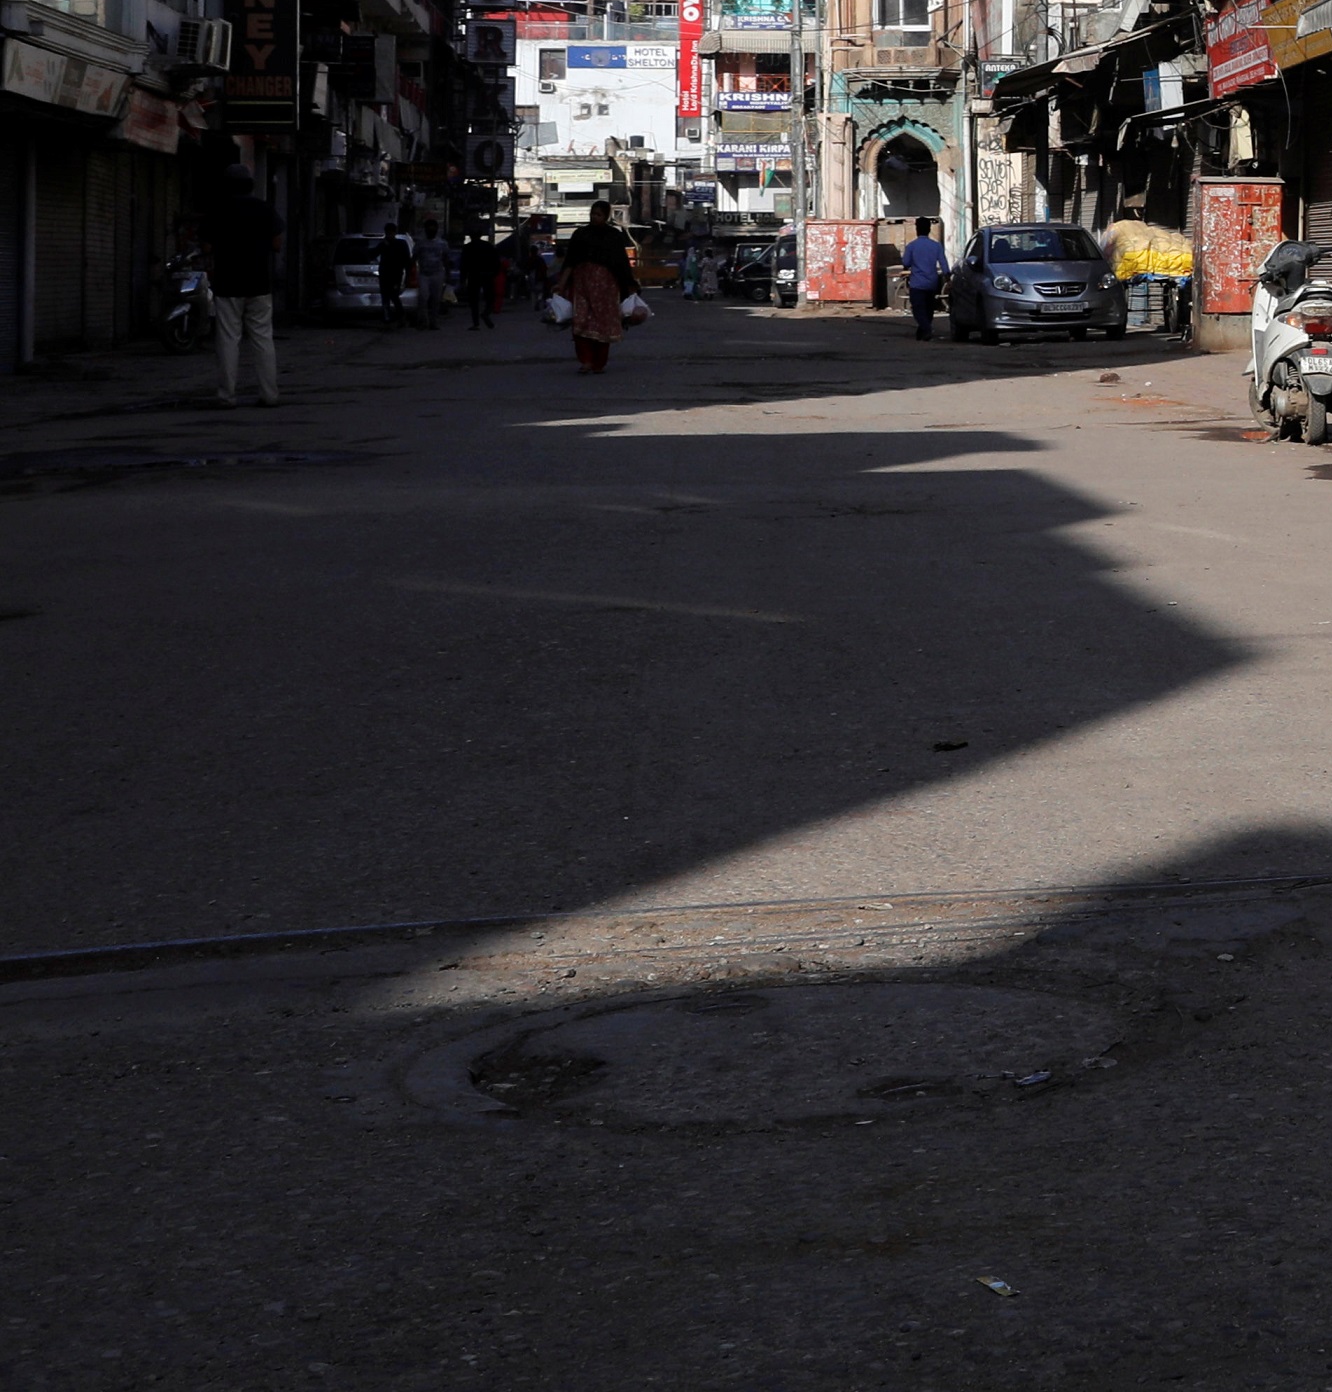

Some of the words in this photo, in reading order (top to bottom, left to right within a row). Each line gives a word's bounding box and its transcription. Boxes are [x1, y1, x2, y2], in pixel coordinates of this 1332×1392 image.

[634, 48, 668, 57] HOTEL
[628, 59, 675, 67] SHELTON
[225, 75, 293, 97] CHANGER
